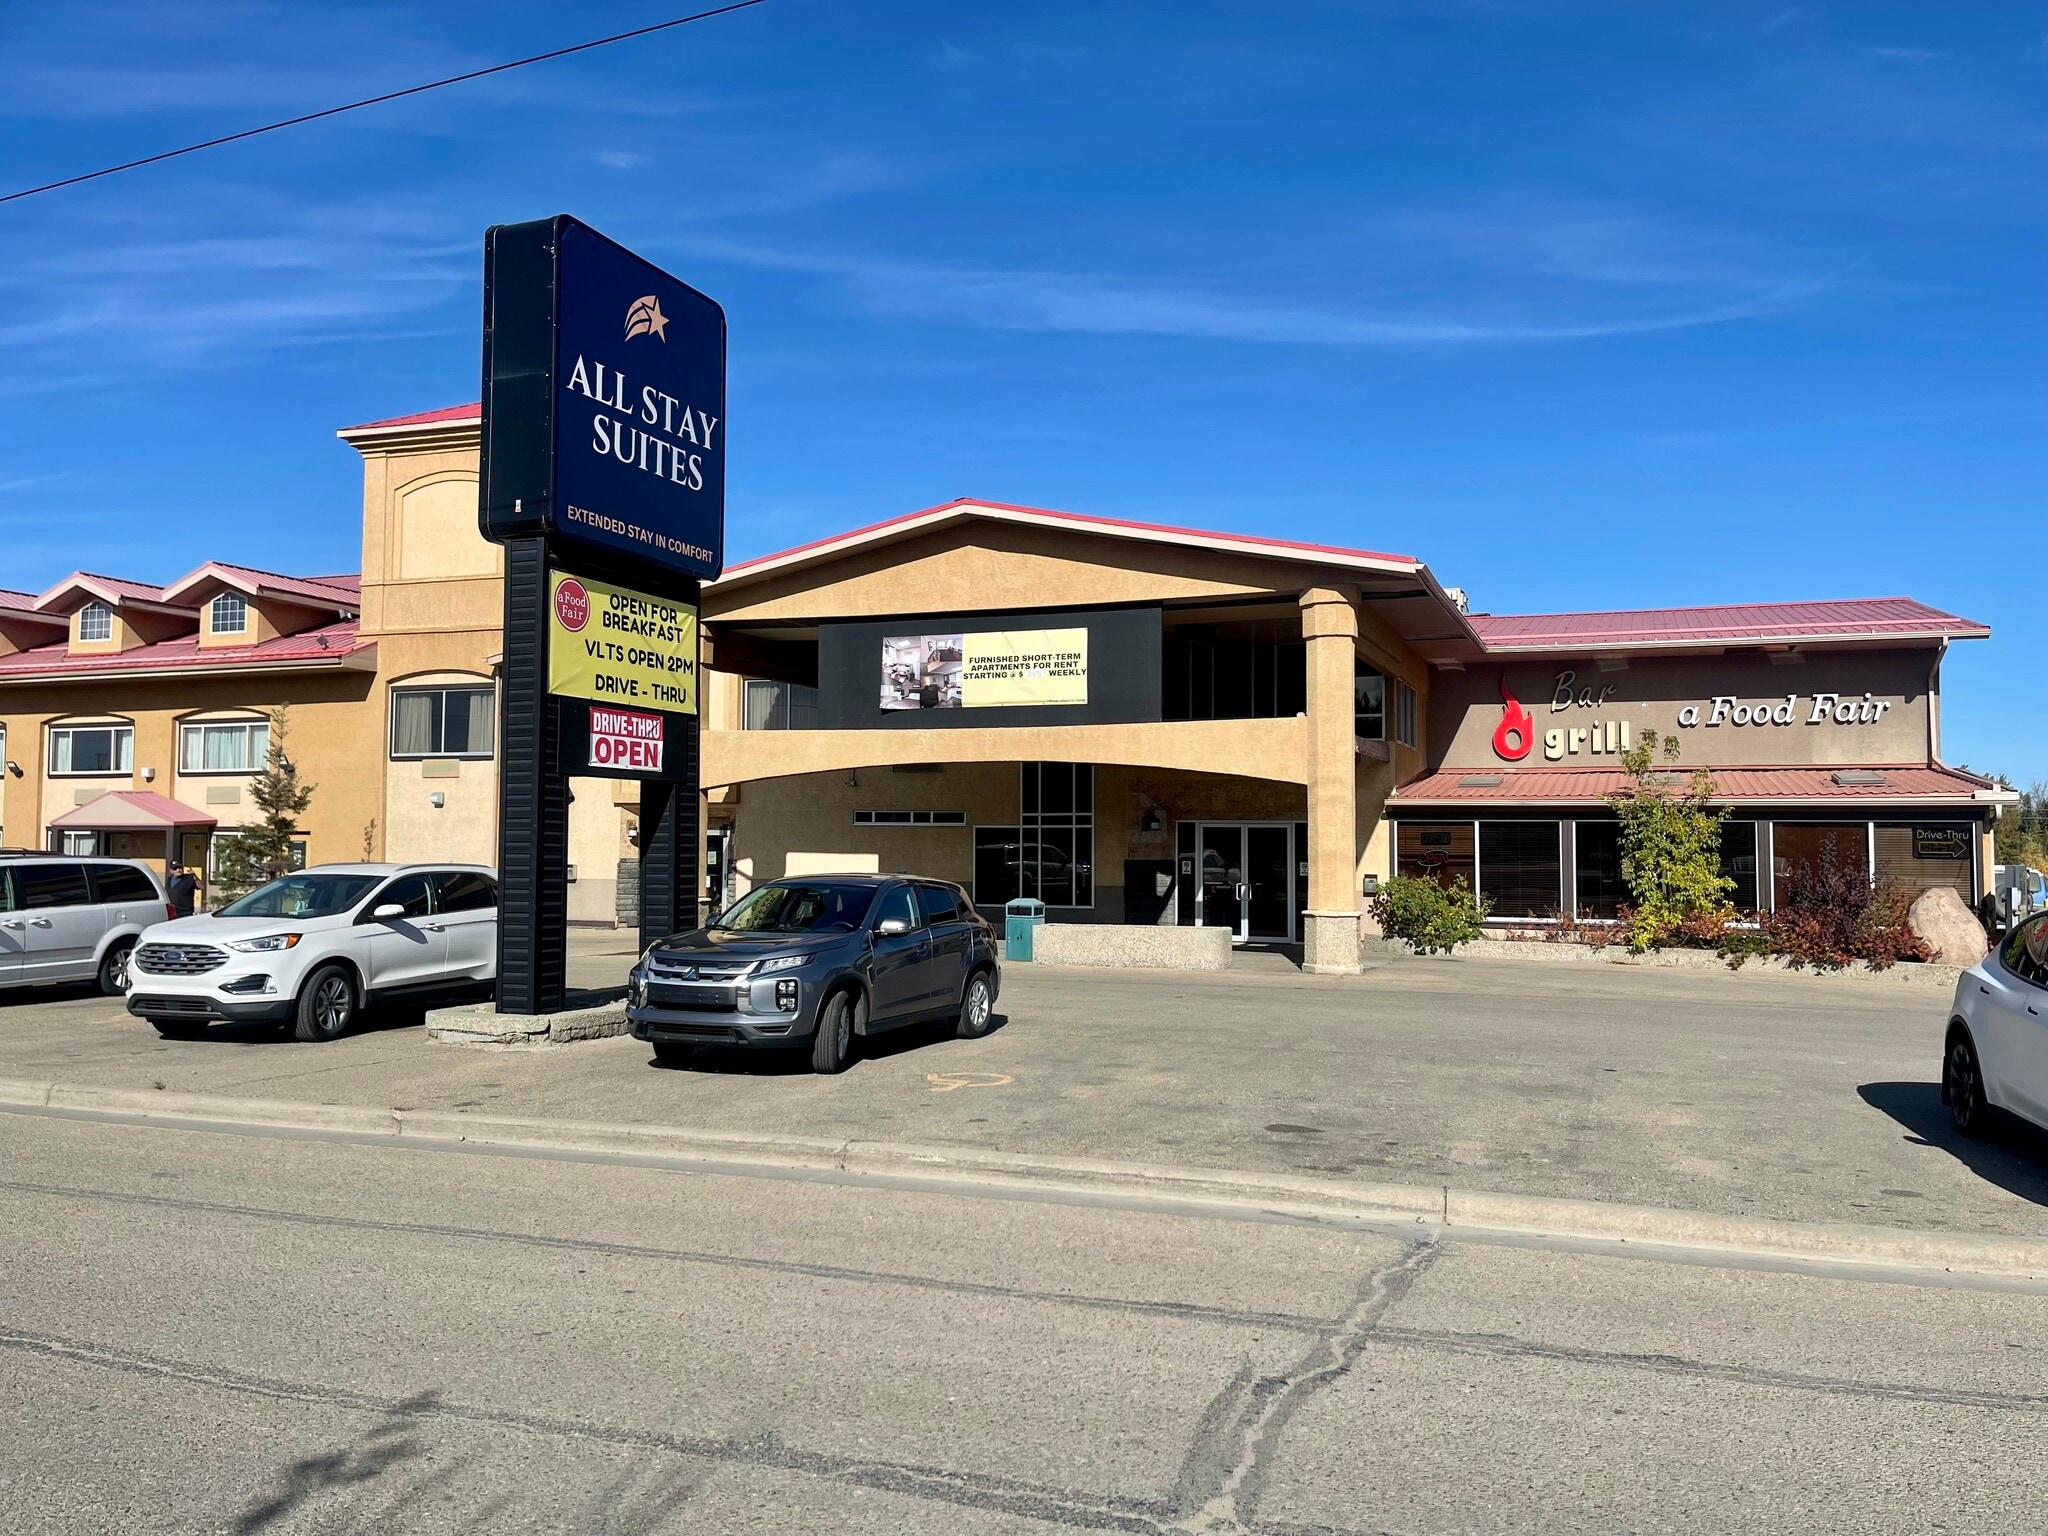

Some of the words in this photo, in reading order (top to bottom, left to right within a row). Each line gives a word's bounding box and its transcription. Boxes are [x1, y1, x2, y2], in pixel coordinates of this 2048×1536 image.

[566, 354, 634, 415] ALL
[641, 386, 718, 450] STAY
[592, 414, 703, 491] SUITES
[567, 505, 626, 535] EXTENDED
[628, 524, 654, 544] STAY
[655, 533, 666, 549] IN
[668, 539, 714, 563] COMFORT
[557, 593, 564, 603] a
[565, 592, 586, 608] Food
[562, 607, 584, 621] Fair
[610, 594, 647, 618] OPEN
[651, 604, 678, 625] FOR
[603, 611, 683, 643] BREAKFAST
[585, 638, 624, 662] VLTS
[628, 648, 664, 670] OPEN
[667, 655, 693, 675] 2PM
[969, 655, 1019, 664] FURNISHED
[1022, 653, 1081, 662] SHORT-TERM
[971, 662, 1031, 671] APARTMENTS
[1033, 661, 1051, 669] FOR
[1054, 660, 1078, 669] RENT
[595, 674, 639, 696] DRIVE
[651, 683, 686, 704] THRU
[963, 671, 1008, 680] STARTING
[1048, 668, 1087, 677] WEEKLY
[1551, 670, 1617, 713] Bar
[593, 712, 660, 739] DRIVE-THRU
[1677, 705, 1700, 728] a
[1705, 694, 1797, 727] Food
[1805, 692, 1891, 726] Fair
[594, 737, 659, 768] OPEN
[1544, 719, 1631, 761] grill
[1916, 829, 1969, 839] Drive-Thru
